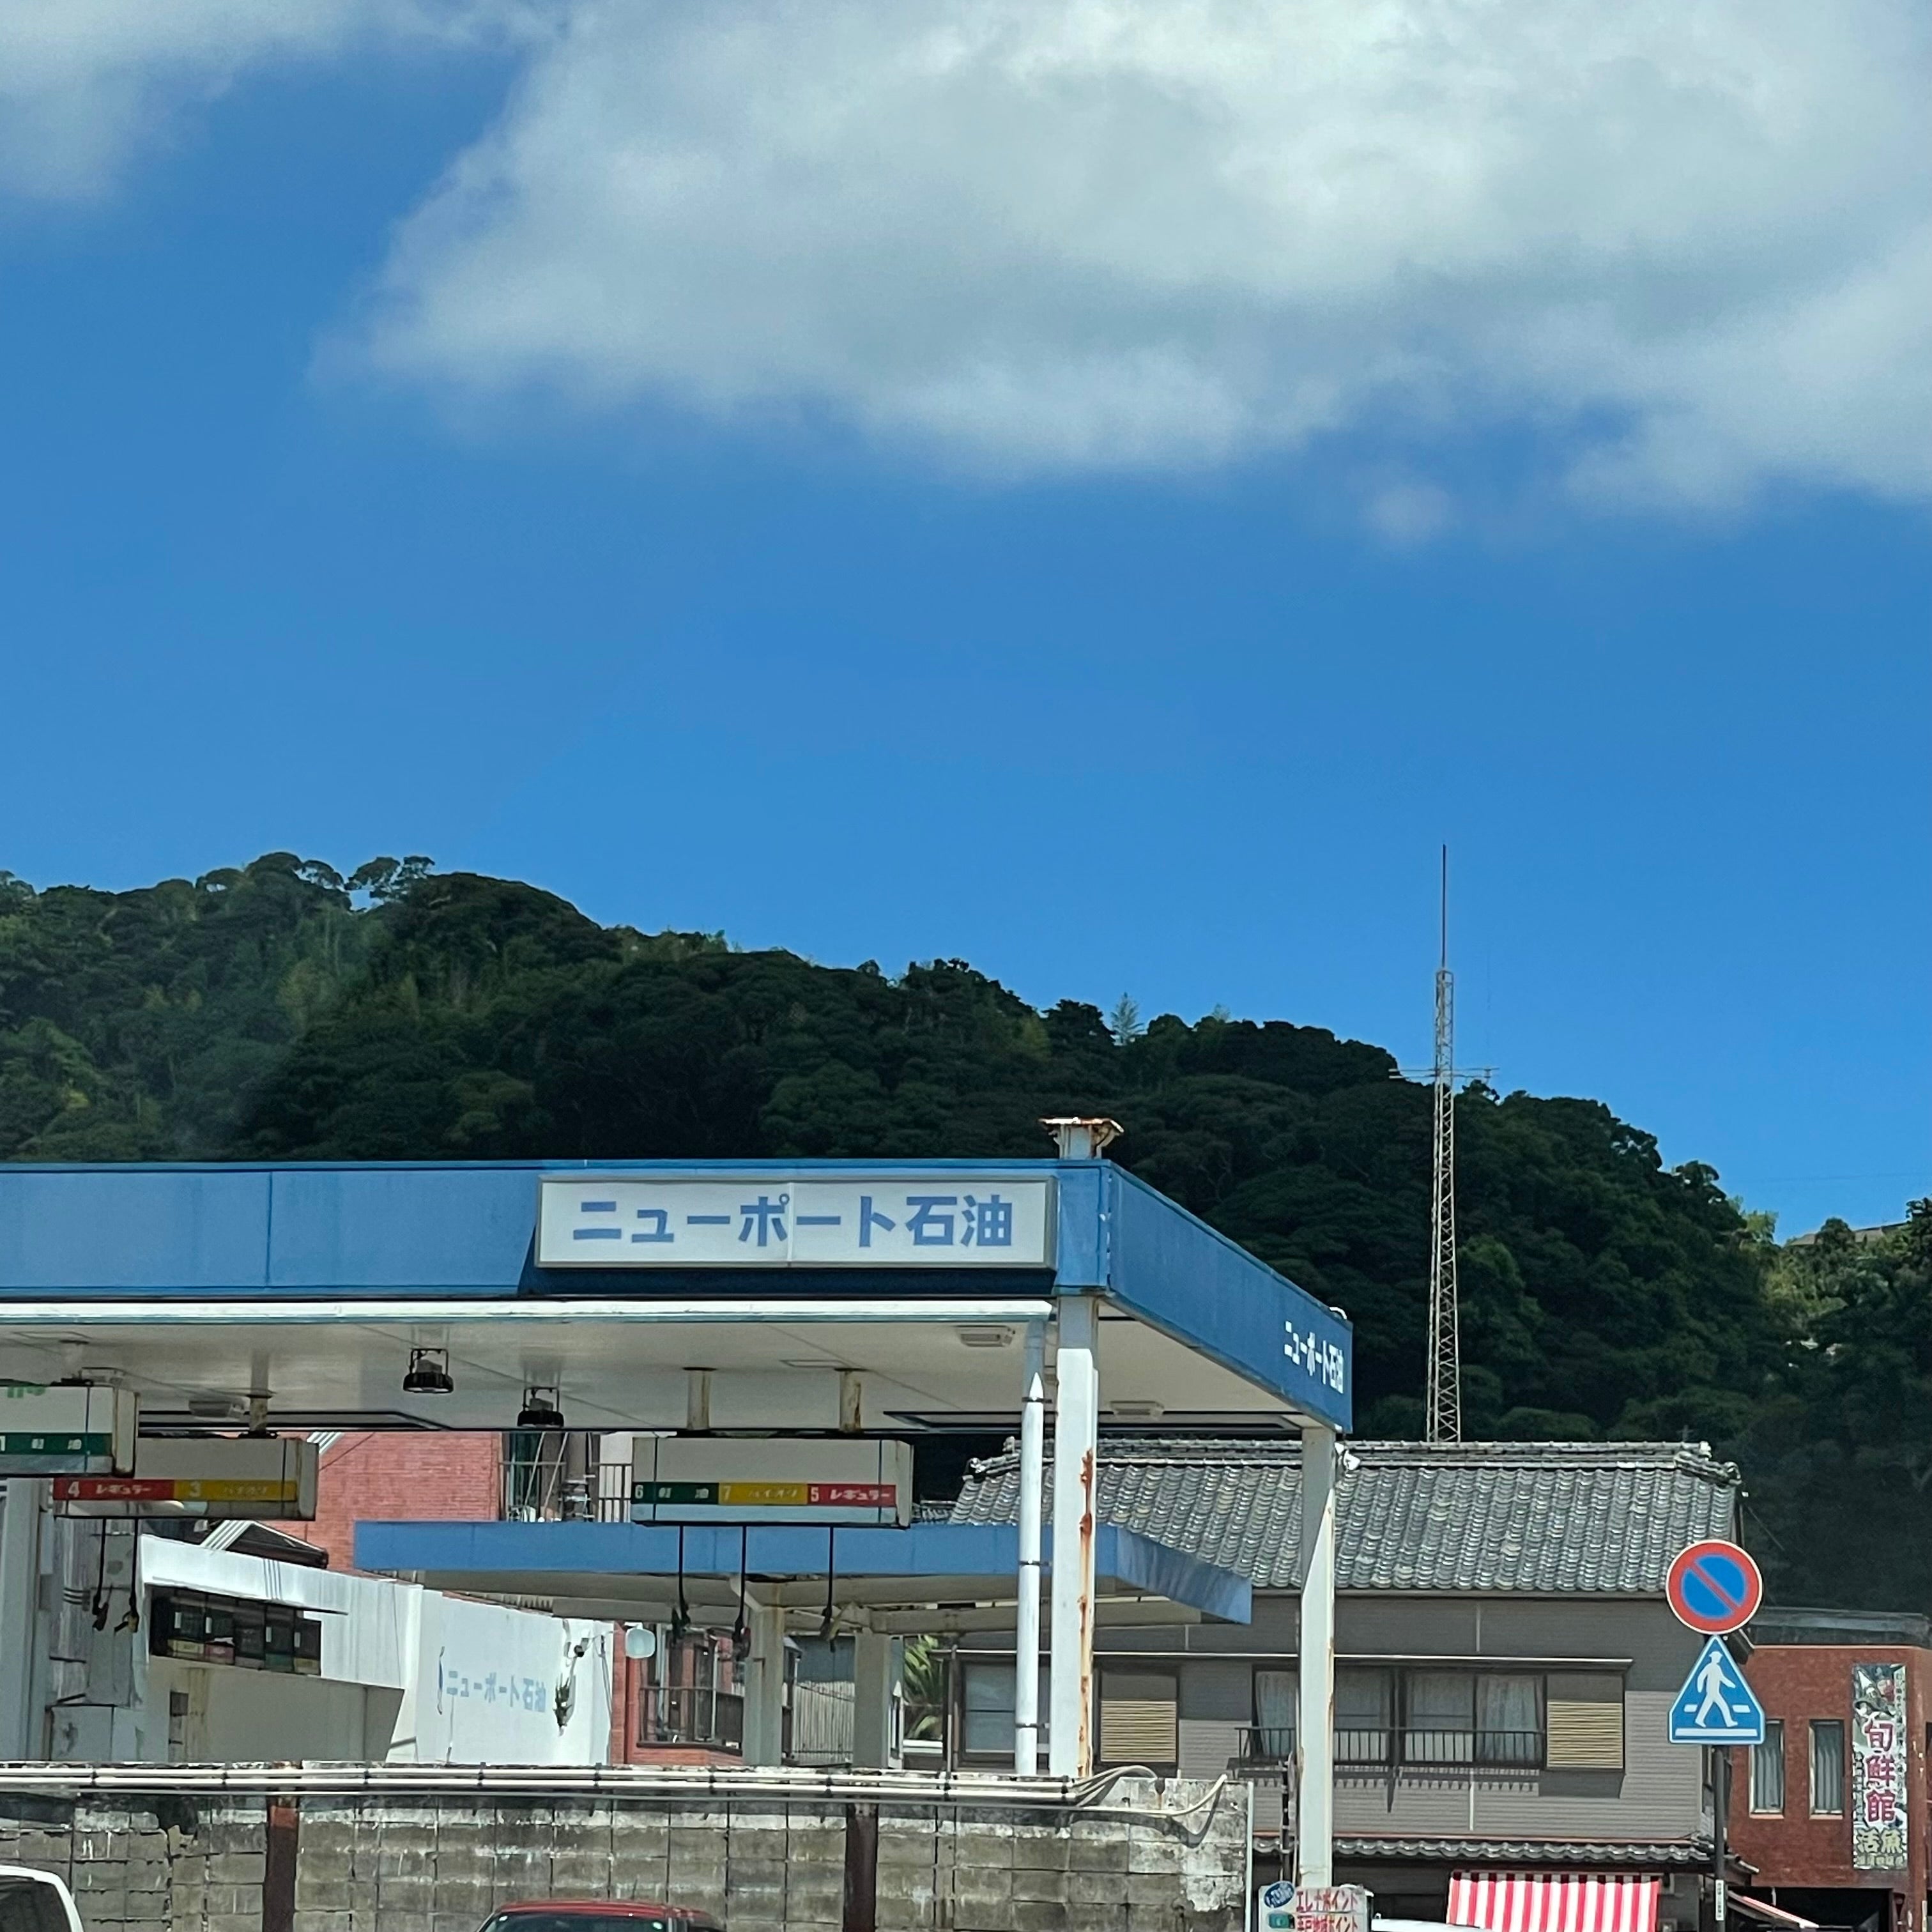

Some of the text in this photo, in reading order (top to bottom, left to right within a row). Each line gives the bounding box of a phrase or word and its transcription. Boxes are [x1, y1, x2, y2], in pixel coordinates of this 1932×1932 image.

[573, 1193, 1013, 1248] ニューポート石油
[68, 1481, 80, 1498] 4
[96, 1483, 152, 1496] レギュラー
[190, 1481, 201, 1498] 3
[634, 1484, 644, 1499] 6
[723, 1485, 732, 1500] 7
[811, 1487, 819, 1502] 5
[831, 1489, 891, 1501] レギュラー
[1864, 1721, 1896, 1822] 旬鮮館
[1856, 1827, 1903, 1853] 活魚
